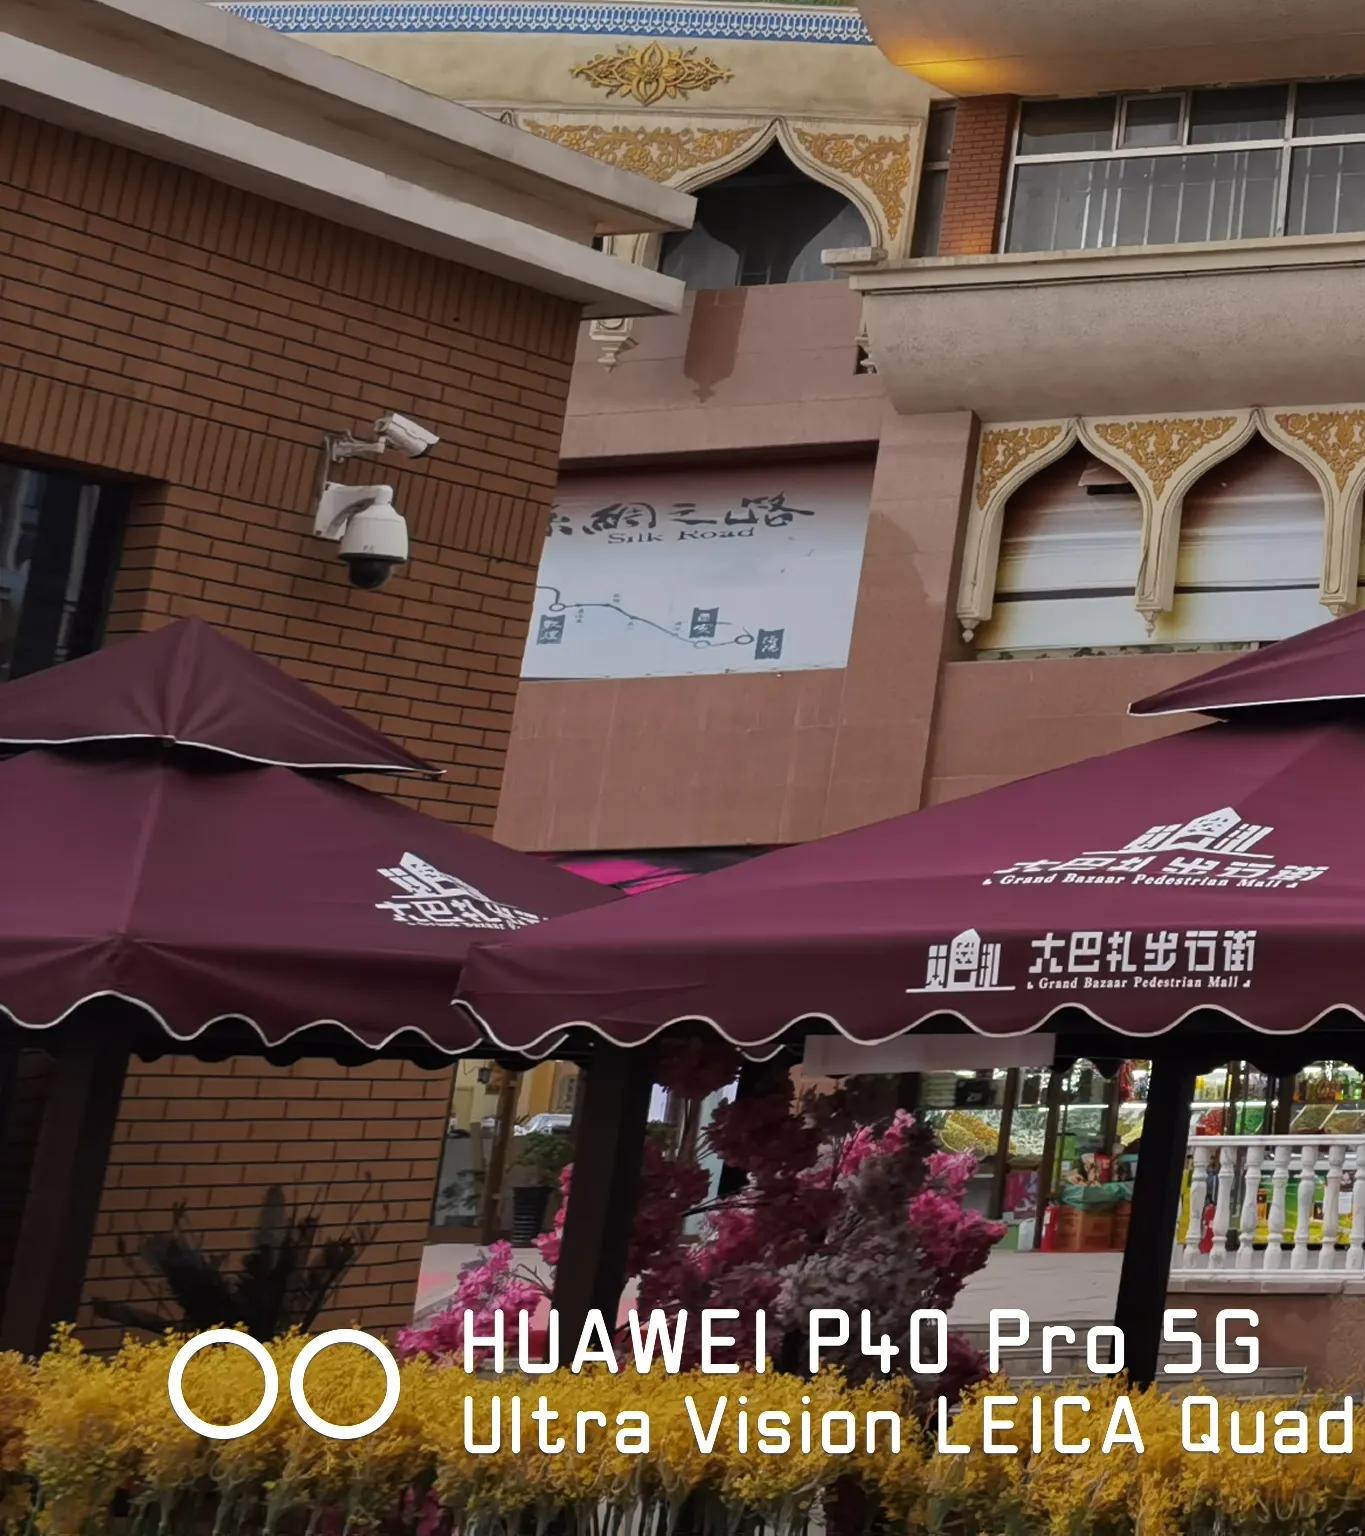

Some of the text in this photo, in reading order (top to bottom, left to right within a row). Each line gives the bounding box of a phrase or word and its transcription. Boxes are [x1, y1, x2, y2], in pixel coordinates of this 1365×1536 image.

[607, 527, 755, 545] Silk Road
[999, 873, 1056, 885] Grand
[1061, 872, 1126, 884] Bazaar
[1131, 873, 1229, 887] Pedestrian
[1029, 930, 1257, 973] 大巴扎步行街
[1038, 975, 1238, 989] Grand Bazaar Pedestrian Mall
